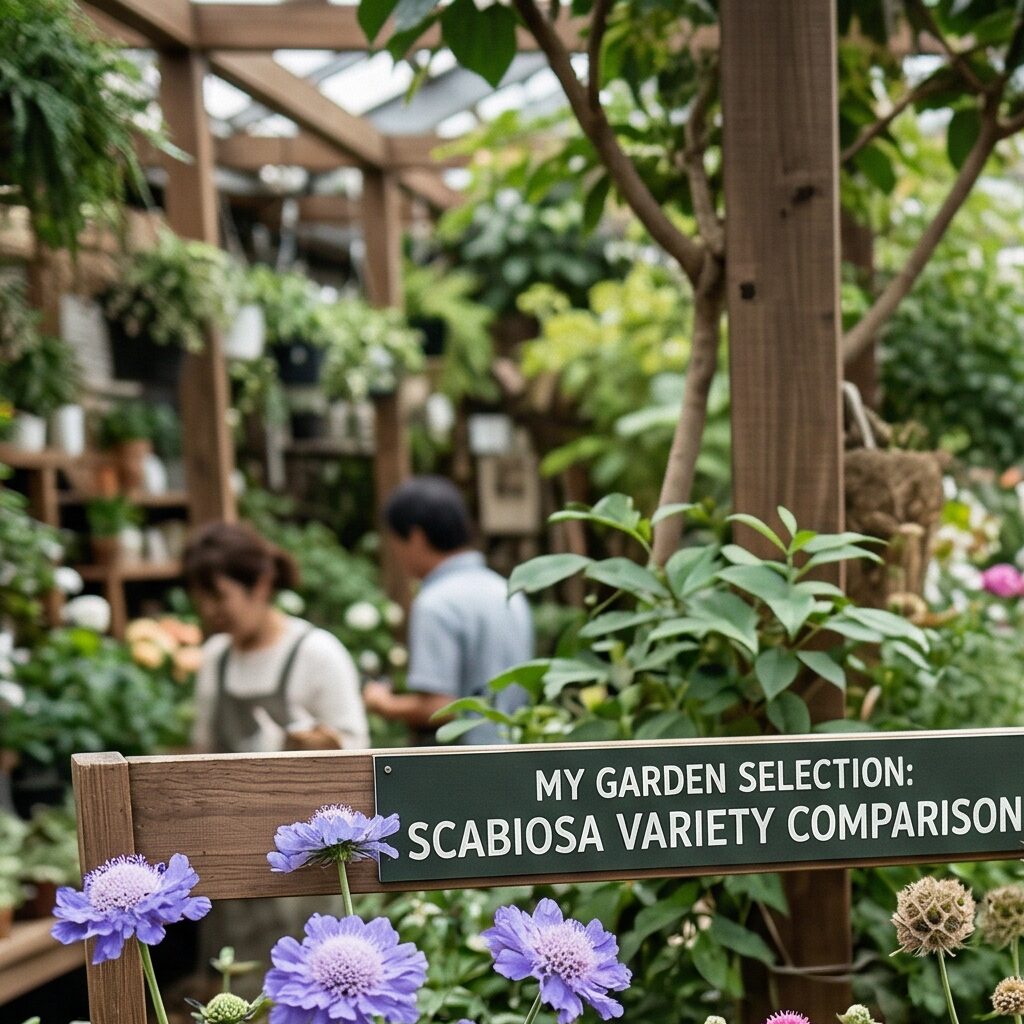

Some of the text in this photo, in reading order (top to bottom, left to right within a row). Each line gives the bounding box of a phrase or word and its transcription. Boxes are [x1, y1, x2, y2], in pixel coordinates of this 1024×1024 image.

[536, 756, 914, 801] MY GARDEN SELECTION:
[408, 796, 1022, 861] SCABIOSA VARIETY COMPARISON
